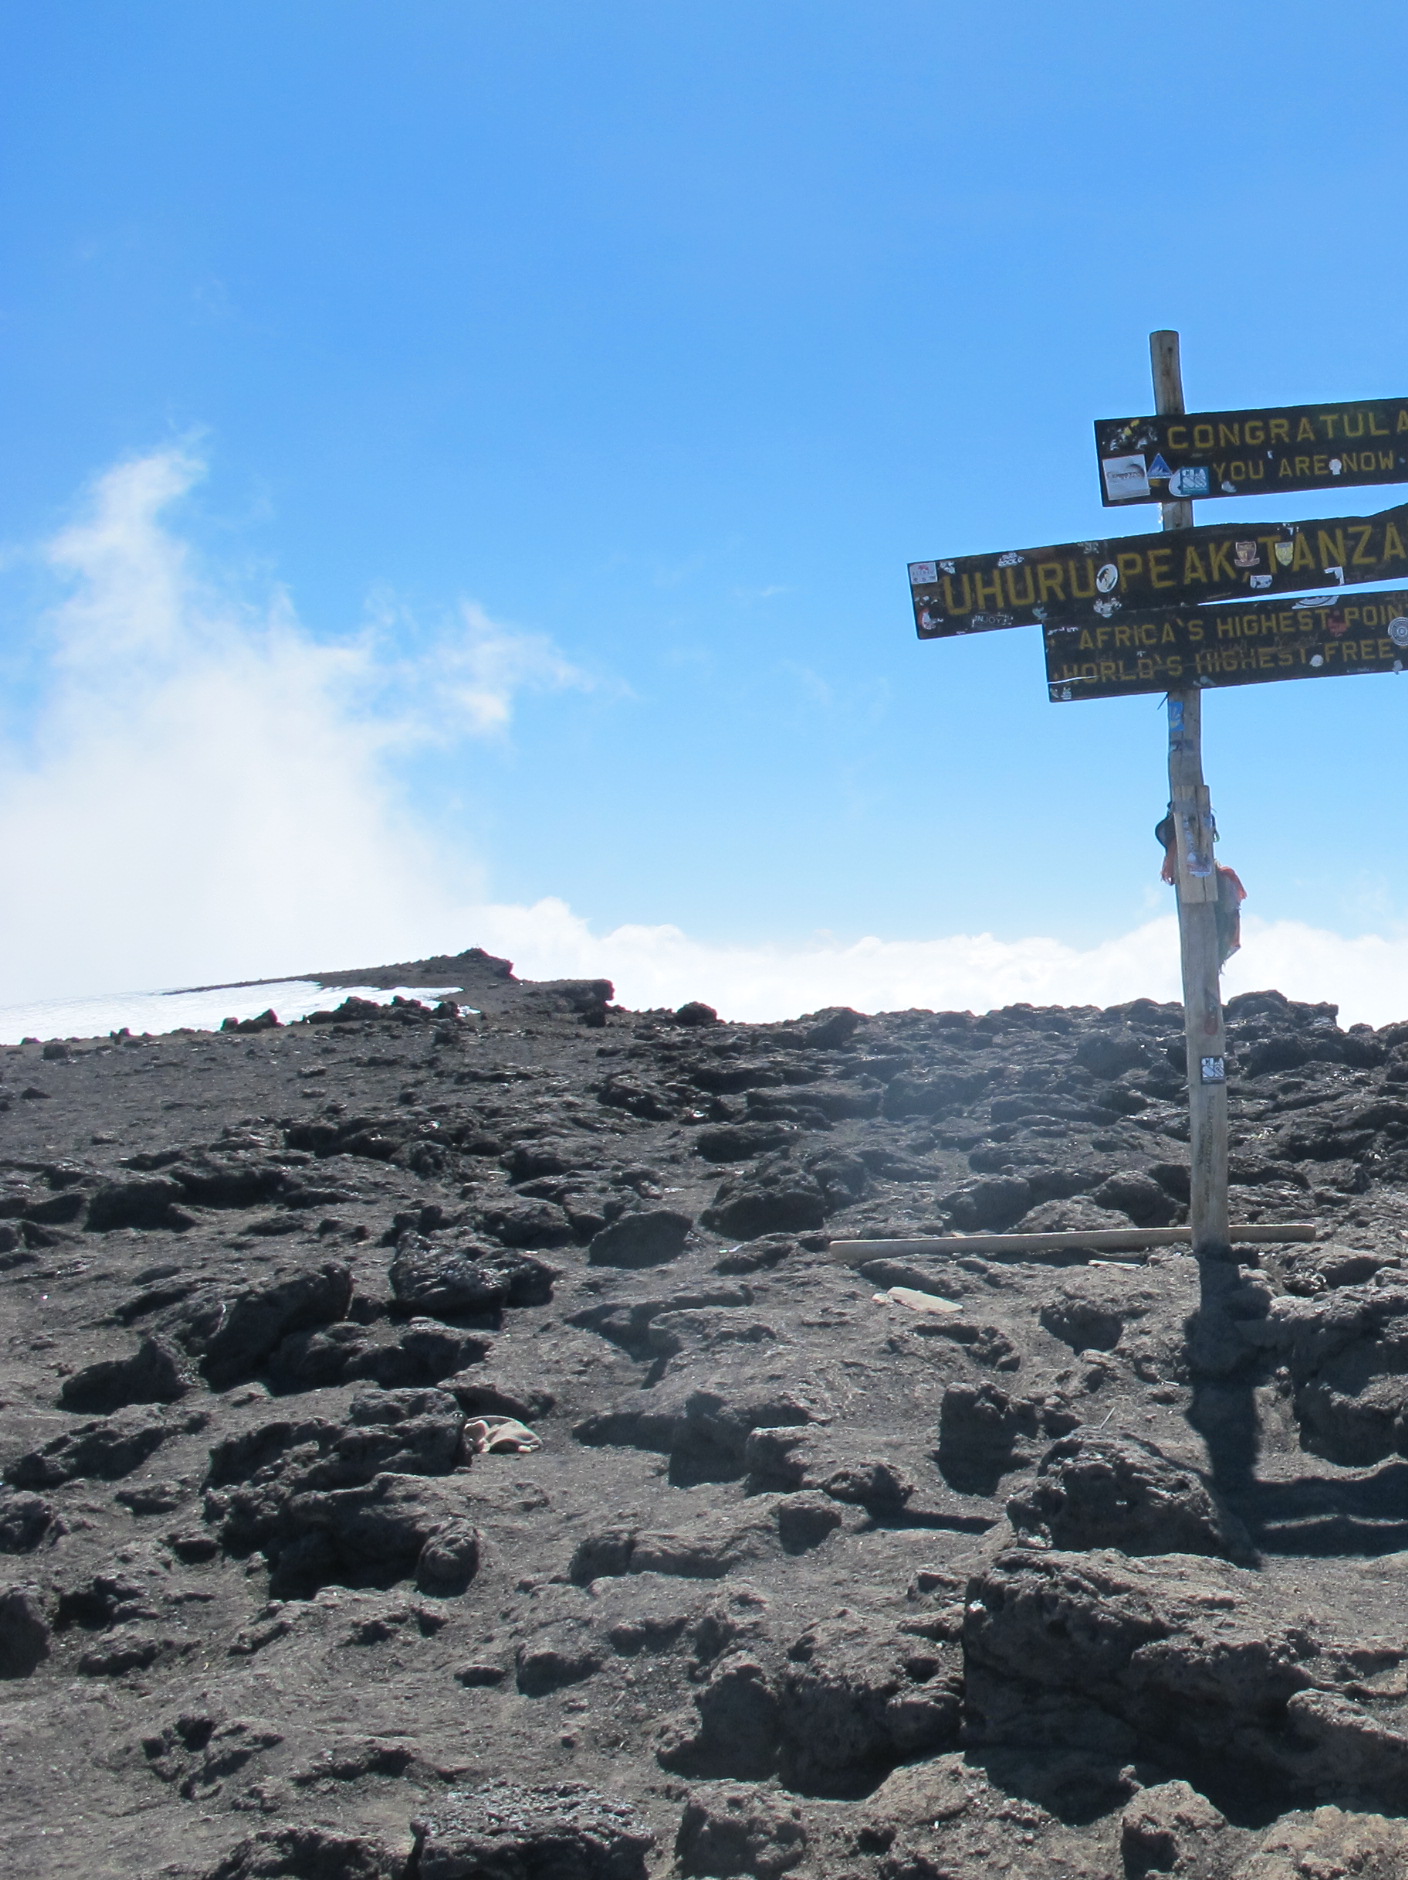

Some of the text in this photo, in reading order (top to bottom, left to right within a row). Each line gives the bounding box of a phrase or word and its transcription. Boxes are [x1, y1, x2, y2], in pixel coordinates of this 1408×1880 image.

[1213, 460, 1265, 482] YOU
[1279, 455, 1330, 478] ARE
[1341, 451, 1395, 472] NOW
[944, 558, 1097, 615] UHURU
[1079, 618, 1204, 650] AFRICA'S
[1217, 609, 1331, 639] HIGHEST
[1063, 654, 1183, 686] WORLD'S
[1196, 645, 1308, 674] HIGHEST
